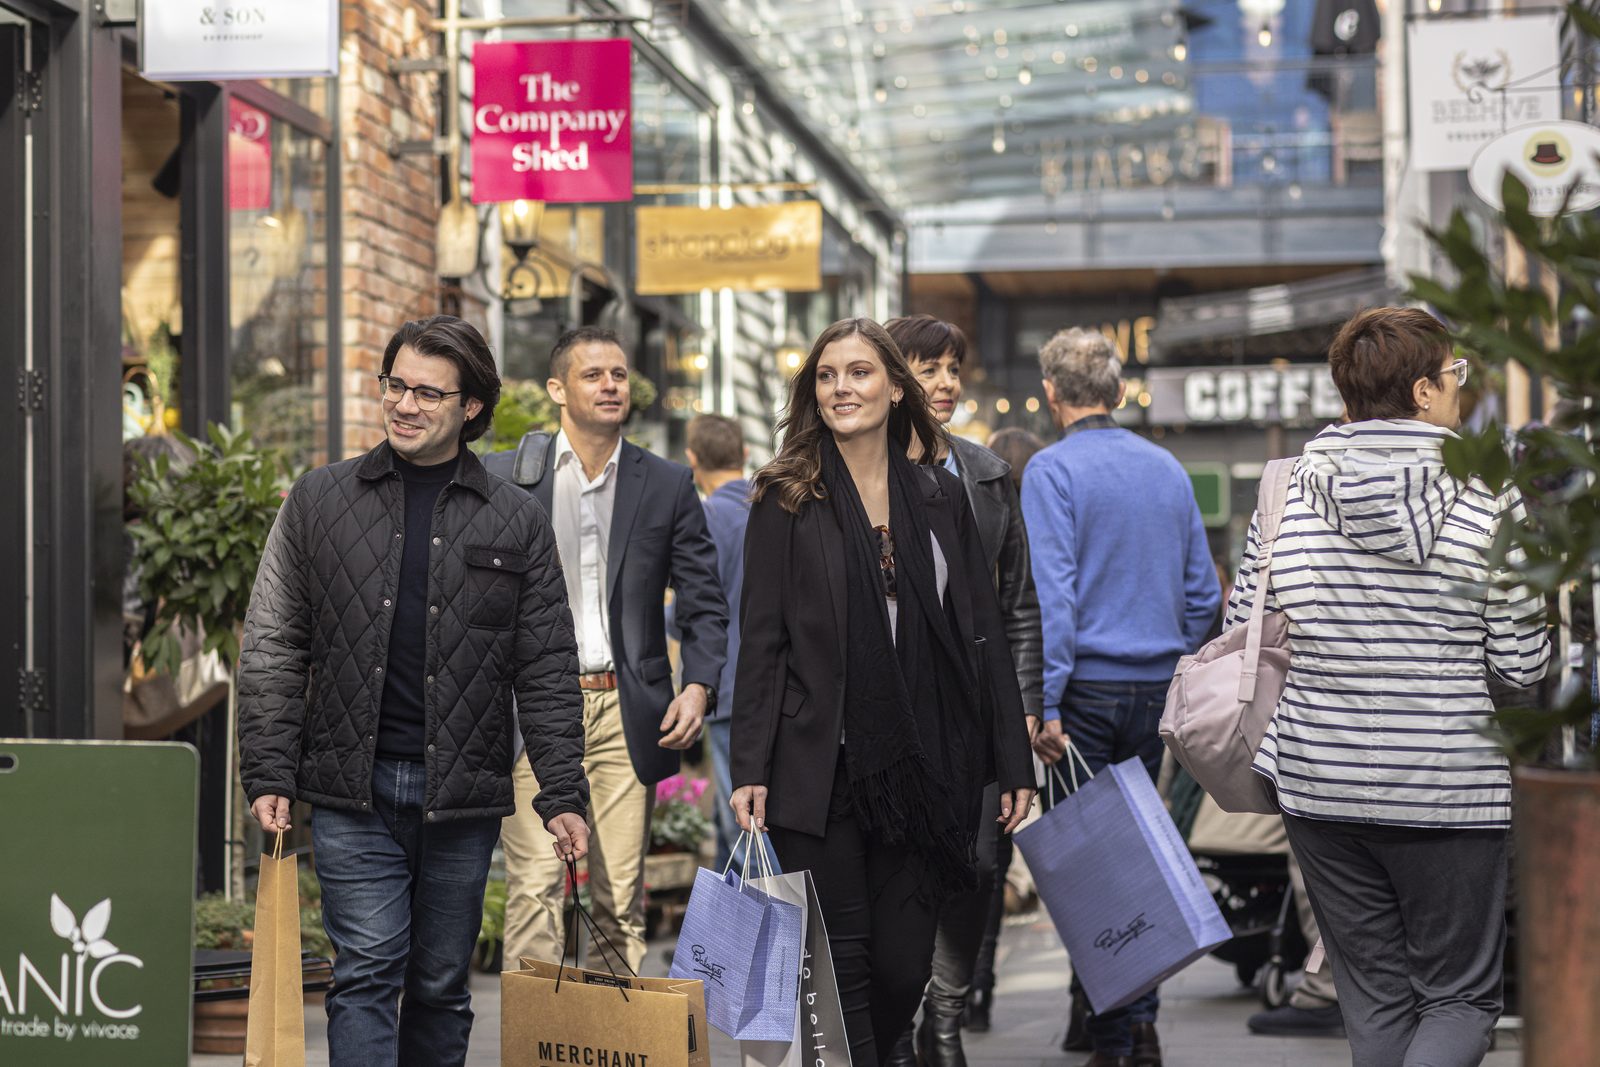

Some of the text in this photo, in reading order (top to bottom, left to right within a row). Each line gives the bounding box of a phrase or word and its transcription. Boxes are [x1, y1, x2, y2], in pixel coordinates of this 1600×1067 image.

[200, 7, 265, 26] & SON
[519, 72, 580, 102] The
[475, 104, 626, 150] Company
[512, 141, 588, 172] Shed
[1, 1014, 140, 1041] trade by vivace
[538, 1041, 648, 1067] MERCHANT
